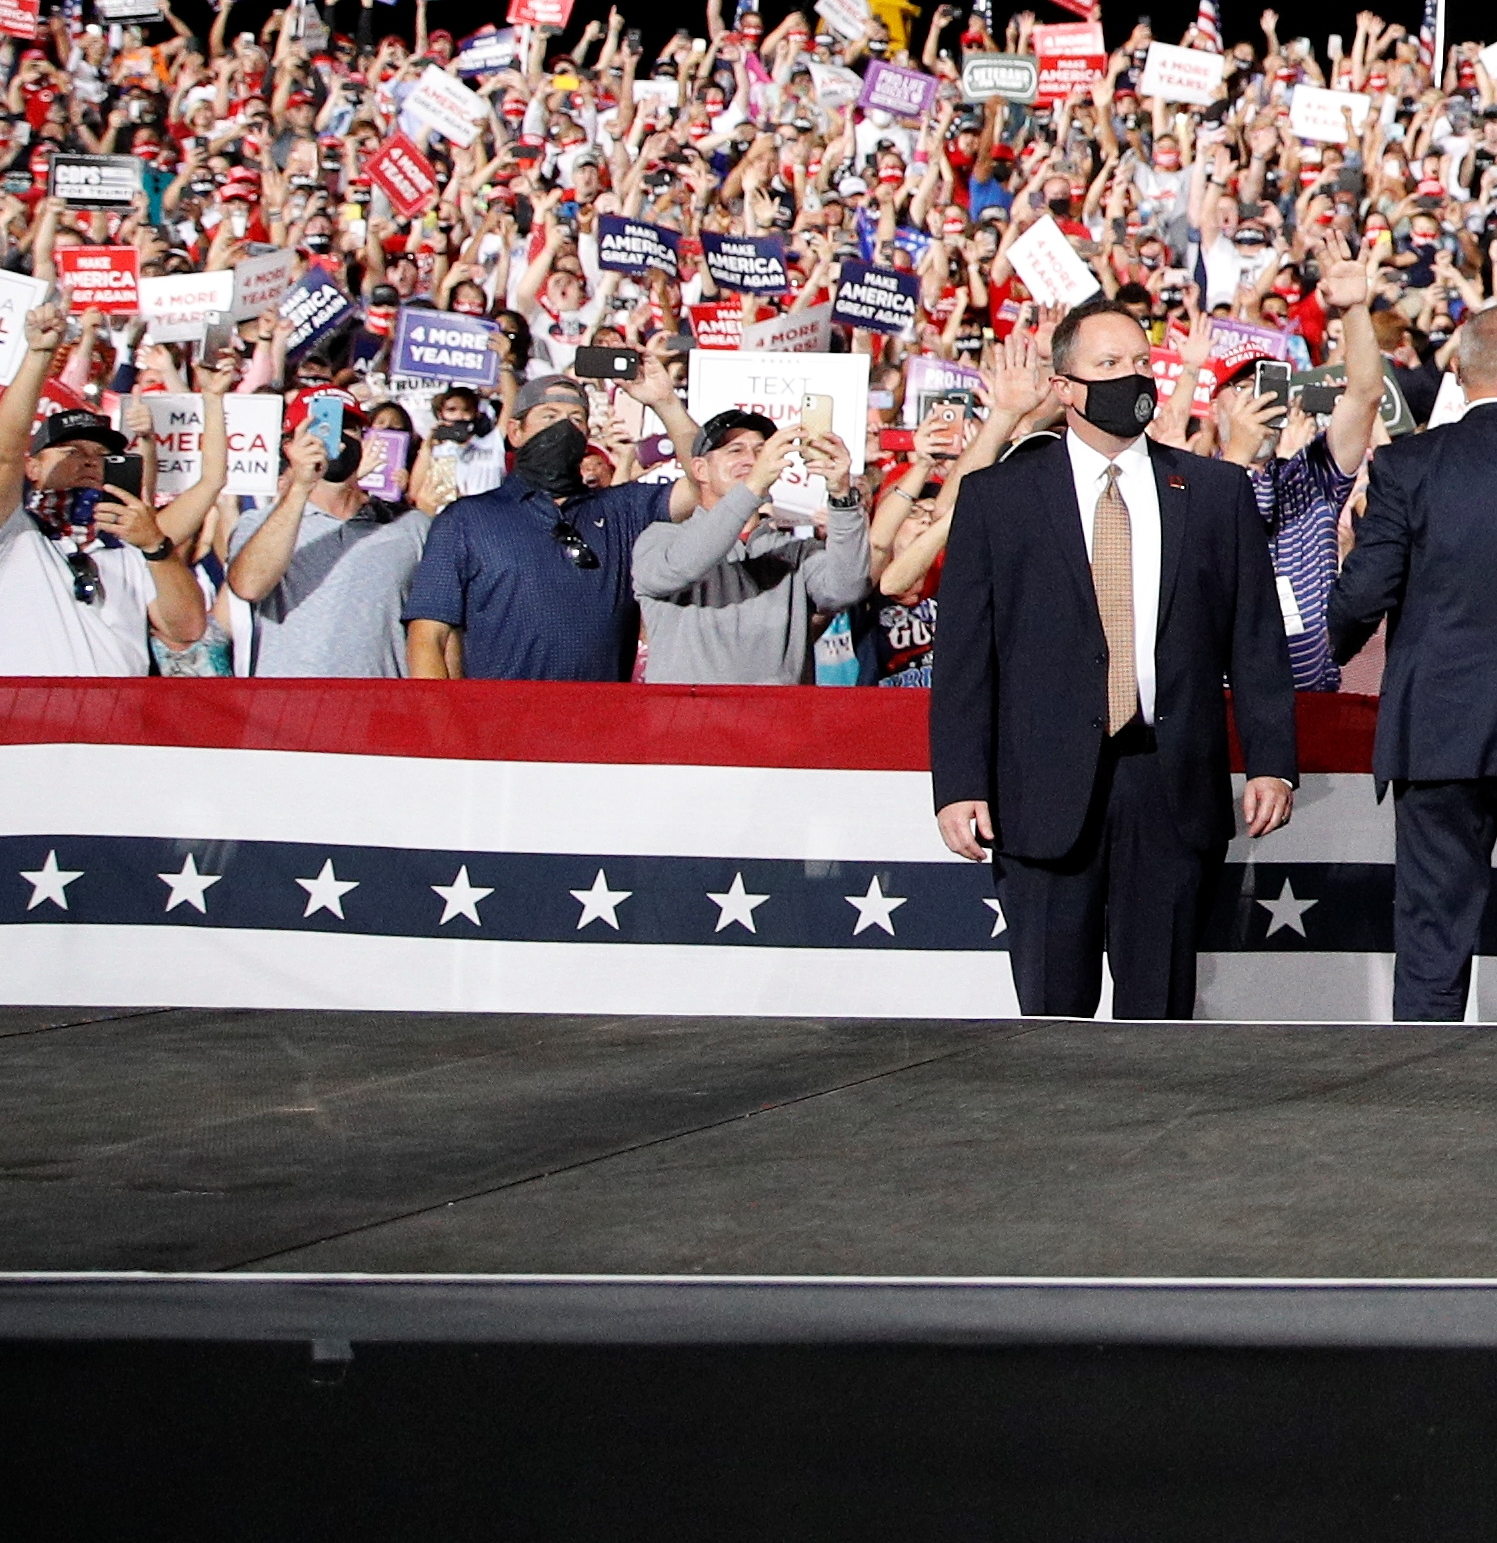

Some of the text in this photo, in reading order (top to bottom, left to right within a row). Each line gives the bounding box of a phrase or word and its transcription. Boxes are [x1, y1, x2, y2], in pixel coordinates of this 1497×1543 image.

[56, 164, 101, 184] COPS
[380, 158, 420, 202] YEARS!
[390, 148, 433, 193] 4 MORE
[625, 224, 659, 243] MAKE
[601, 234, 677, 265] AMERICA
[601, 250, 645, 265] GREAT
[721, 242, 756, 258] MAKE
[77, 257, 112, 269] MAKE
[707, 251, 784, 275] AMERICA
[1046, 251, 1077, 290] MORE
[64, 271, 137, 288] AMERICA
[742, 273, 786, 288] AGAIN
[864, 272, 898, 292] MAKE
[94, 290, 138, 303] AGAIN
[154, 291, 218, 307] 4 MORE
[839, 281, 916, 314] AMERICA
[311, 294, 348, 328] AGAIN
[836, 300, 914, 329] GREAT AGAIN
[410, 326, 488, 351] 4 MORE
[756, 322, 819, 348] 4 MORE
[410, 345, 484, 369] YEARS!
[1152, 360, 1167, 376] 4
[748, 376, 813, 395] TEXT
[158, 460, 195, 473] EAT
